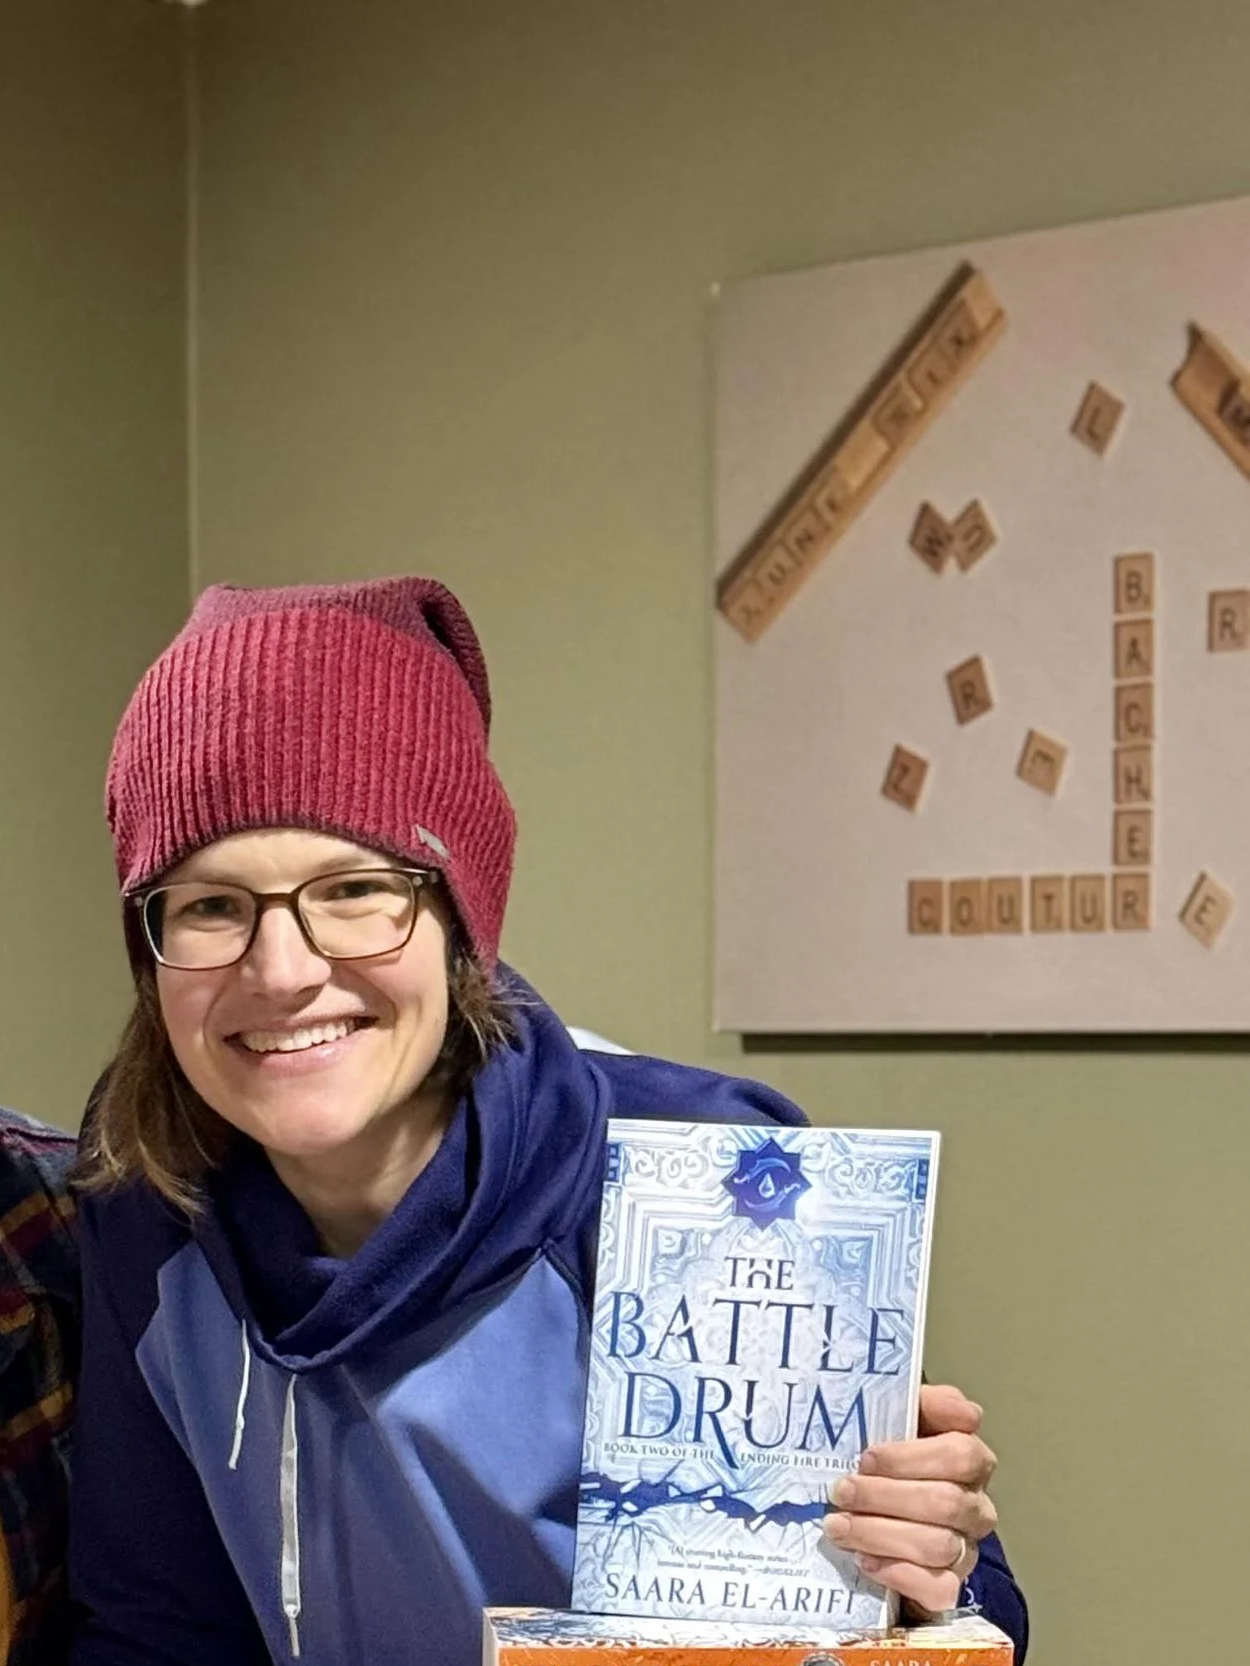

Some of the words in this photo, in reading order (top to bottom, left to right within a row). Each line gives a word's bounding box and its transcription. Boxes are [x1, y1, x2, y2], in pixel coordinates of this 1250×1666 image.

[724, 1257, 794, 1290] THE
[607, 1291, 903, 1376] BATTLE
[622, 1371, 867, 1469] DRUM
[604, 1442, 638, 1455] BOOK
[642, 1445, 670, 1457] TWO
[672, 1448, 687, 1458] OF
[690, 1449, 714, 1460] THE
[740, 1452, 789, 1465] ENDING
[793, 1455, 820, 1468] FIRE
[605, 1572, 705, 1605] SAARA
[722, 1580, 854, 1615] EL-ARIFI
